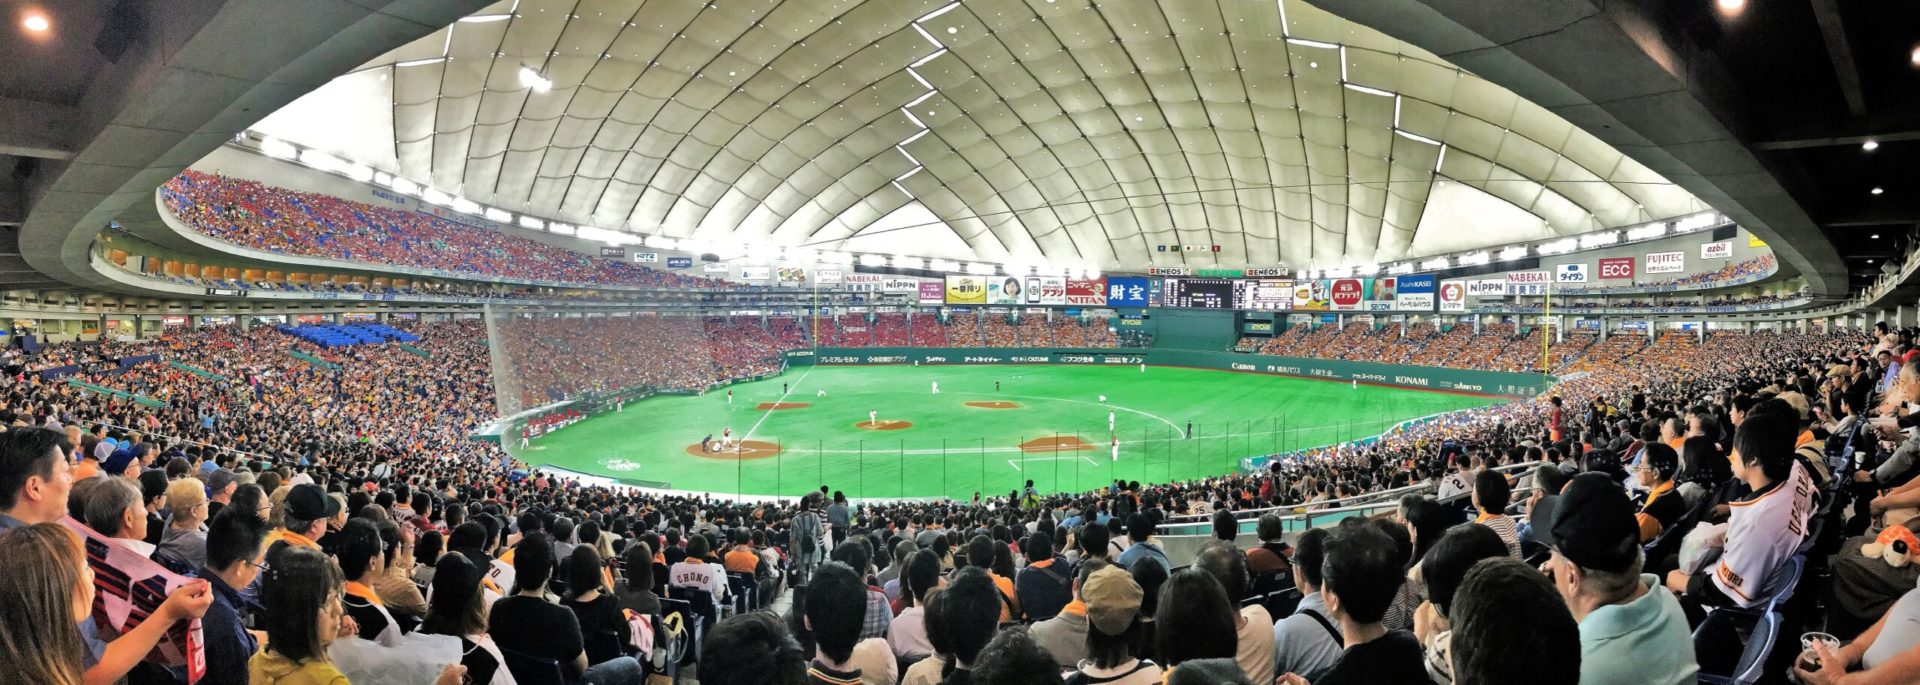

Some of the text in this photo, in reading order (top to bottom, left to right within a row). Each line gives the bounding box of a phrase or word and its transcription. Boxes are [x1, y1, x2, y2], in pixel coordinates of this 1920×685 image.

[1707, 243, 1726, 252] azbil
[1647, 254, 1682, 264] FUJITEC
[1603, 264, 1630, 276] ECC
[886, 279, 916, 289] NIPPN
[952, 285, 981, 293] 一番搾り
[1470, 280, 1503, 291] NIPPN
[1042, 289, 1064, 297] アプリ
[1109, 284, 1144, 301] 財宝
[1067, 296, 1106, 304] NITTAN
[1231, 362, 1256, 371] Canon
[1395, 375, 1428, 386] KONAMI
[1453, 381, 1482, 391] SANKYO
[677, 572, 710, 585] CHONO
